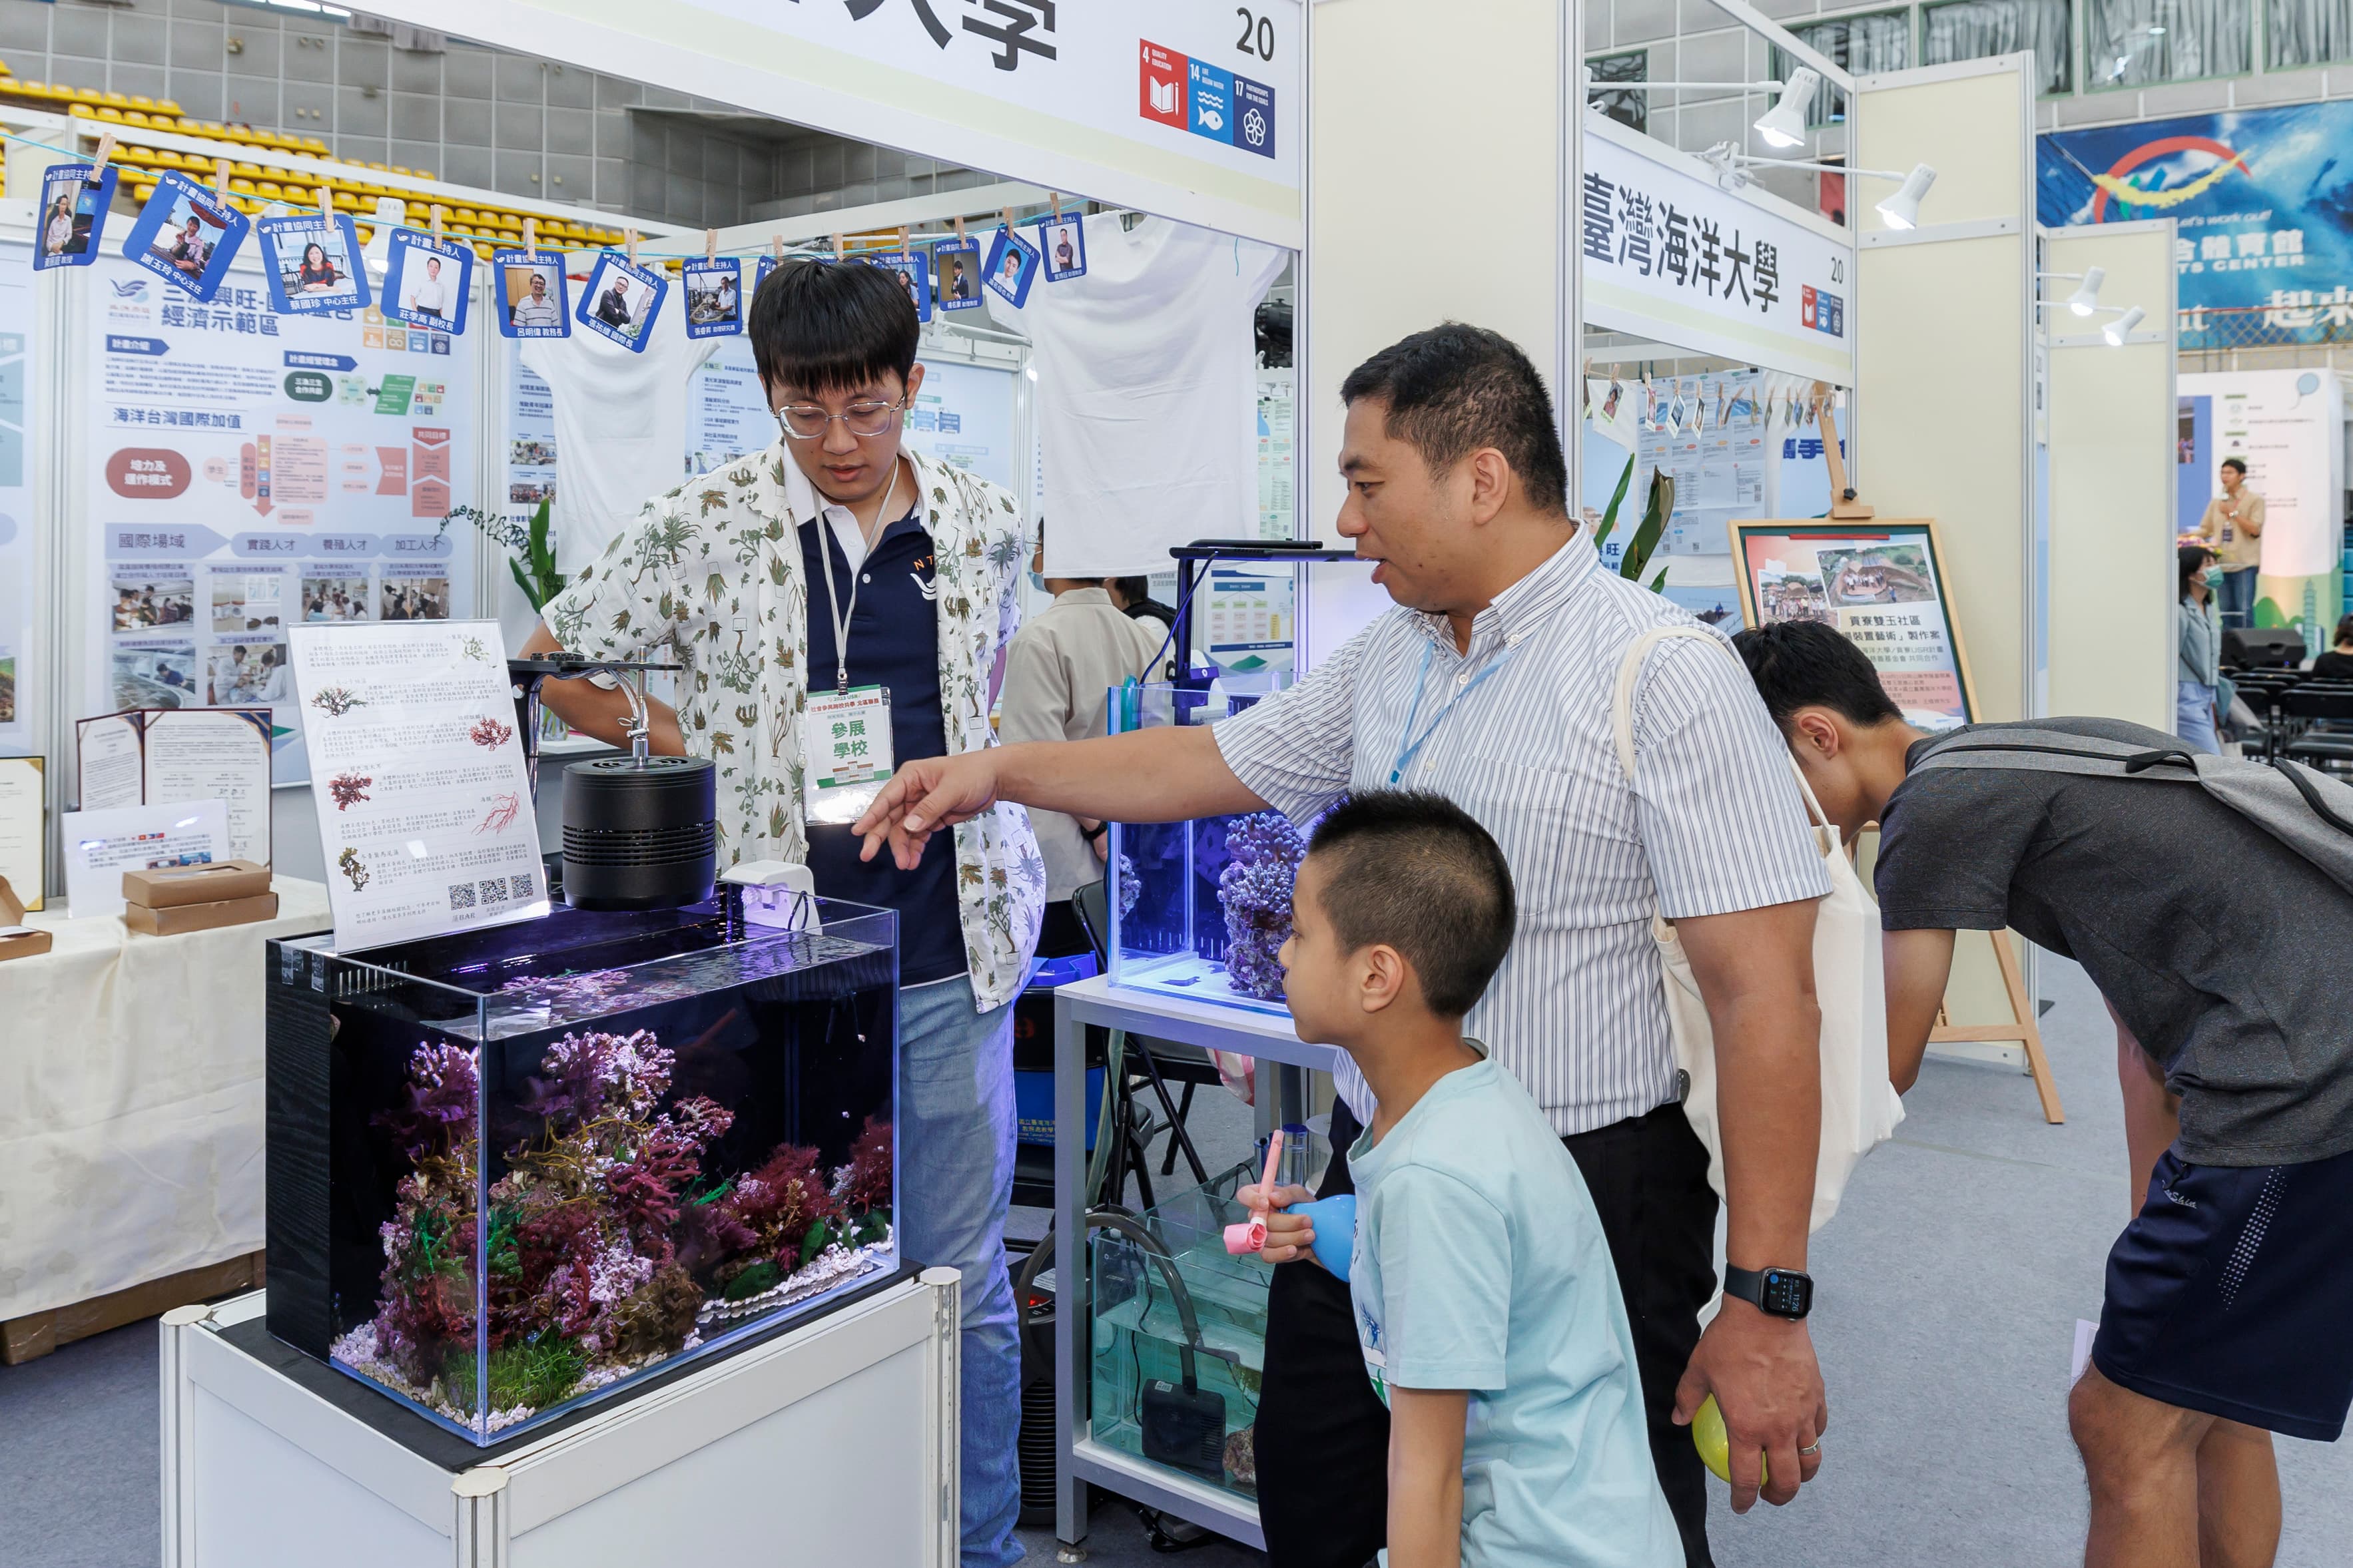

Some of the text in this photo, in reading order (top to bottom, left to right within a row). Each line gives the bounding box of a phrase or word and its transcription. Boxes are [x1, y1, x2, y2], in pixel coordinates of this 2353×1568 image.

[1236, 7, 1274, 61] 20
[1142, 46, 1150, 63] 4
[1190, 63, 1200, 81] 14
[1235, 79, 1244, 97] 17
[271, 218, 344, 233] 計畫協同主人
[1584, 172, 1779, 313] 臺灣海洋大學
[1831, 256, 1844, 284] 20
[2212, 255, 2306, 272] CENTER
[141, 252, 203, 295] 謝玉玲 中心主任
[289, 295, 358, 310] 蔡國珍 中心主任
[161, 304, 280, 337] 經濟示範區
[428, 319, 454, 332] 副校長
[542, 328, 563, 338] 教務長
[113, 407, 242, 429] 海洋台灣國際加值
[118, 533, 186, 550] 國際場域
[396, 539, 438, 551] 加工人才
[1850, 615, 1921, 627] 貢寮雙玉社區
[1907, 630, 1941, 641] 製作案
[831, 720, 866, 739] 參展
[833, 740, 868, 759] 學校
